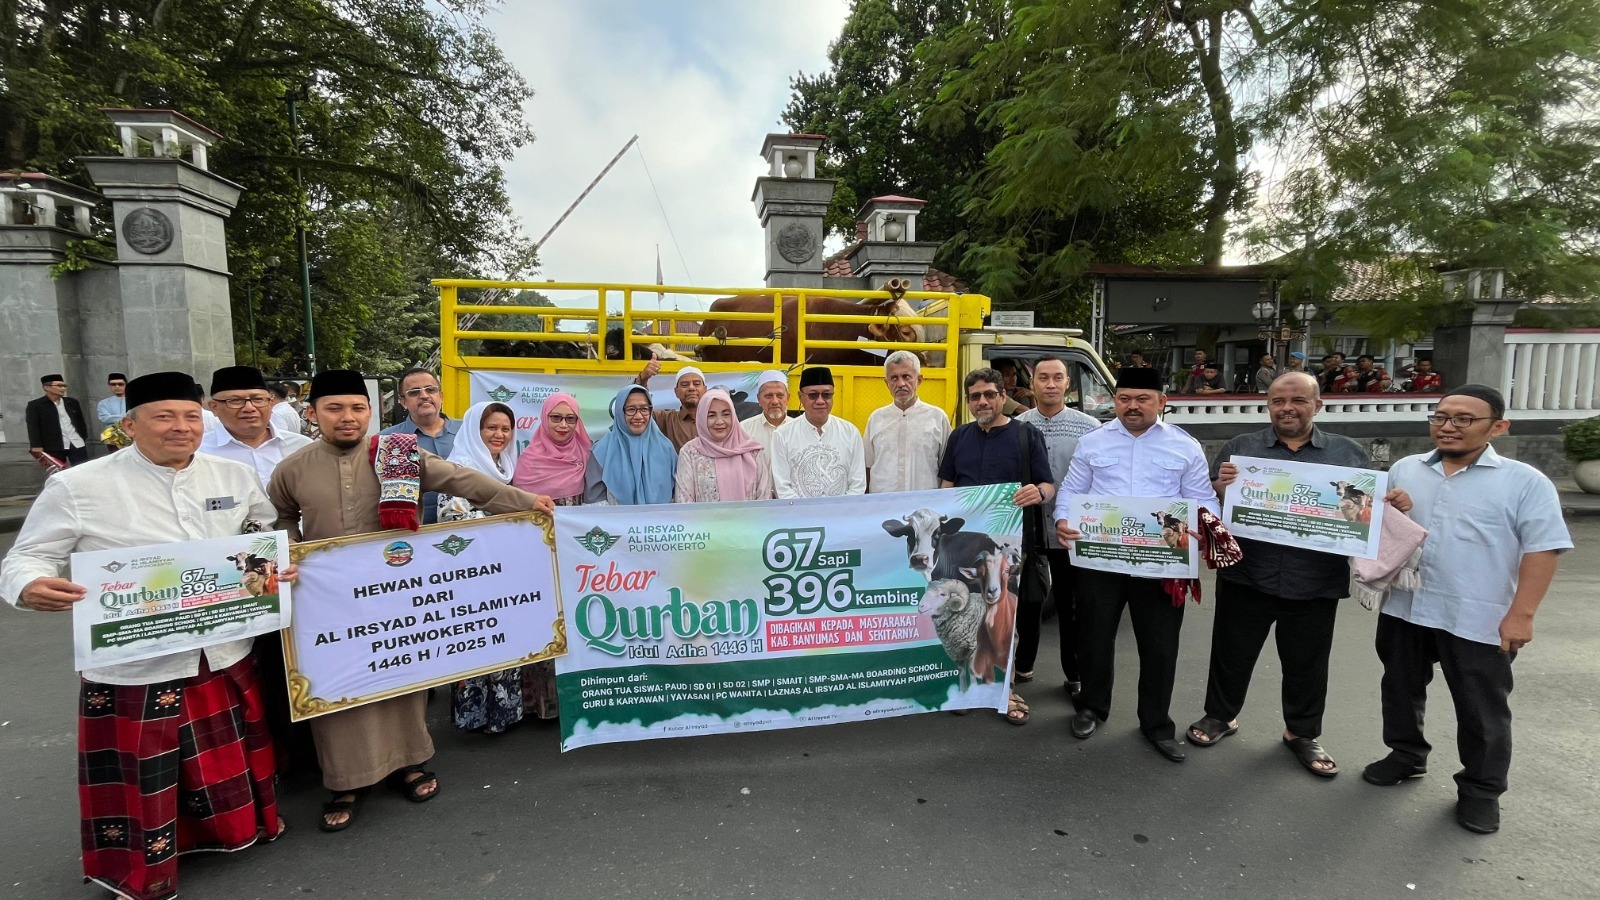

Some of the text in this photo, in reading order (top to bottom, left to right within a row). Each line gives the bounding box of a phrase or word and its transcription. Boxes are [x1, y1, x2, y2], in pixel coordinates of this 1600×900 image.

[1241, 486, 1290, 503] Qurban
[1293, 484, 1311, 495] 67
[1291, 494, 1318, 506] 396
[628, 524, 685, 534] AL IRSYAD
[1080, 522, 1120, 536] Qurban
[1122, 517, 1136, 527] 67
[628, 532, 711, 543] AL ISLAMIYYAH
[1122, 527, 1144, 537] 396
[629, 541, 706, 552] PURWOKERTO
[763, 527, 849, 571] 67 Sapi
[181, 568, 205, 583] 67
[353, 563, 502, 598] HEWAN QURBAN
[575, 561, 656, 593] Tebar
[101, 581, 136, 592] Tebar
[181, 580, 216, 597] 396
[764, 570, 919, 616] 396 Kambing
[100, 586, 180, 612] Qurban
[412, 590, 454, 607] DARI
[125, 608, 149, 616] Adha
[314, 590, 541, 646] AL IRSYAD AL ISLAMIYAH
[575, 587, 760, 656] Qurban
[770, 616, 917, 634] DIBAGIKAN KEPADA MASYARAKAT
[371, 617, 498, 653] PURWOKERTO
[845, 631, 863, 643] DAN
[869, 628, 920, 642] SEKITARNYA
[367, 633, 506, 672] 1446 H / 2025 M
[629, 639, 763, 659] Idul Adha 1446 H
[581, 673, 648, 687] Dihimpun dari:
[582, 688, 612, 698] ORANG
[615, 687, 632, 695] TUA
[634, 685, 663, 694] SISWA:
[777, 676, 803, 686] SMAIT
[809, 672, 865, 684] SMP-SMA-MA
[866, 668, 907, 678] BOARDING
[909, 664, 939, 674] SCHOOL
[583, 699, 606, 709] GURU
[616, 695, 664, 706] KARYAWAN
[729, 690, 762, 698] WANITA
[768, 687, 800, 697] LAZNAS
[803, 686, 813, 694] AL
[815, 683, 844, 693] IRSYAD
[847, 682, 856, 690] AL
[858, 678, 906, 689] ISLAMIYYAH
[908, 669, 959, 684] PURWOKERTO
